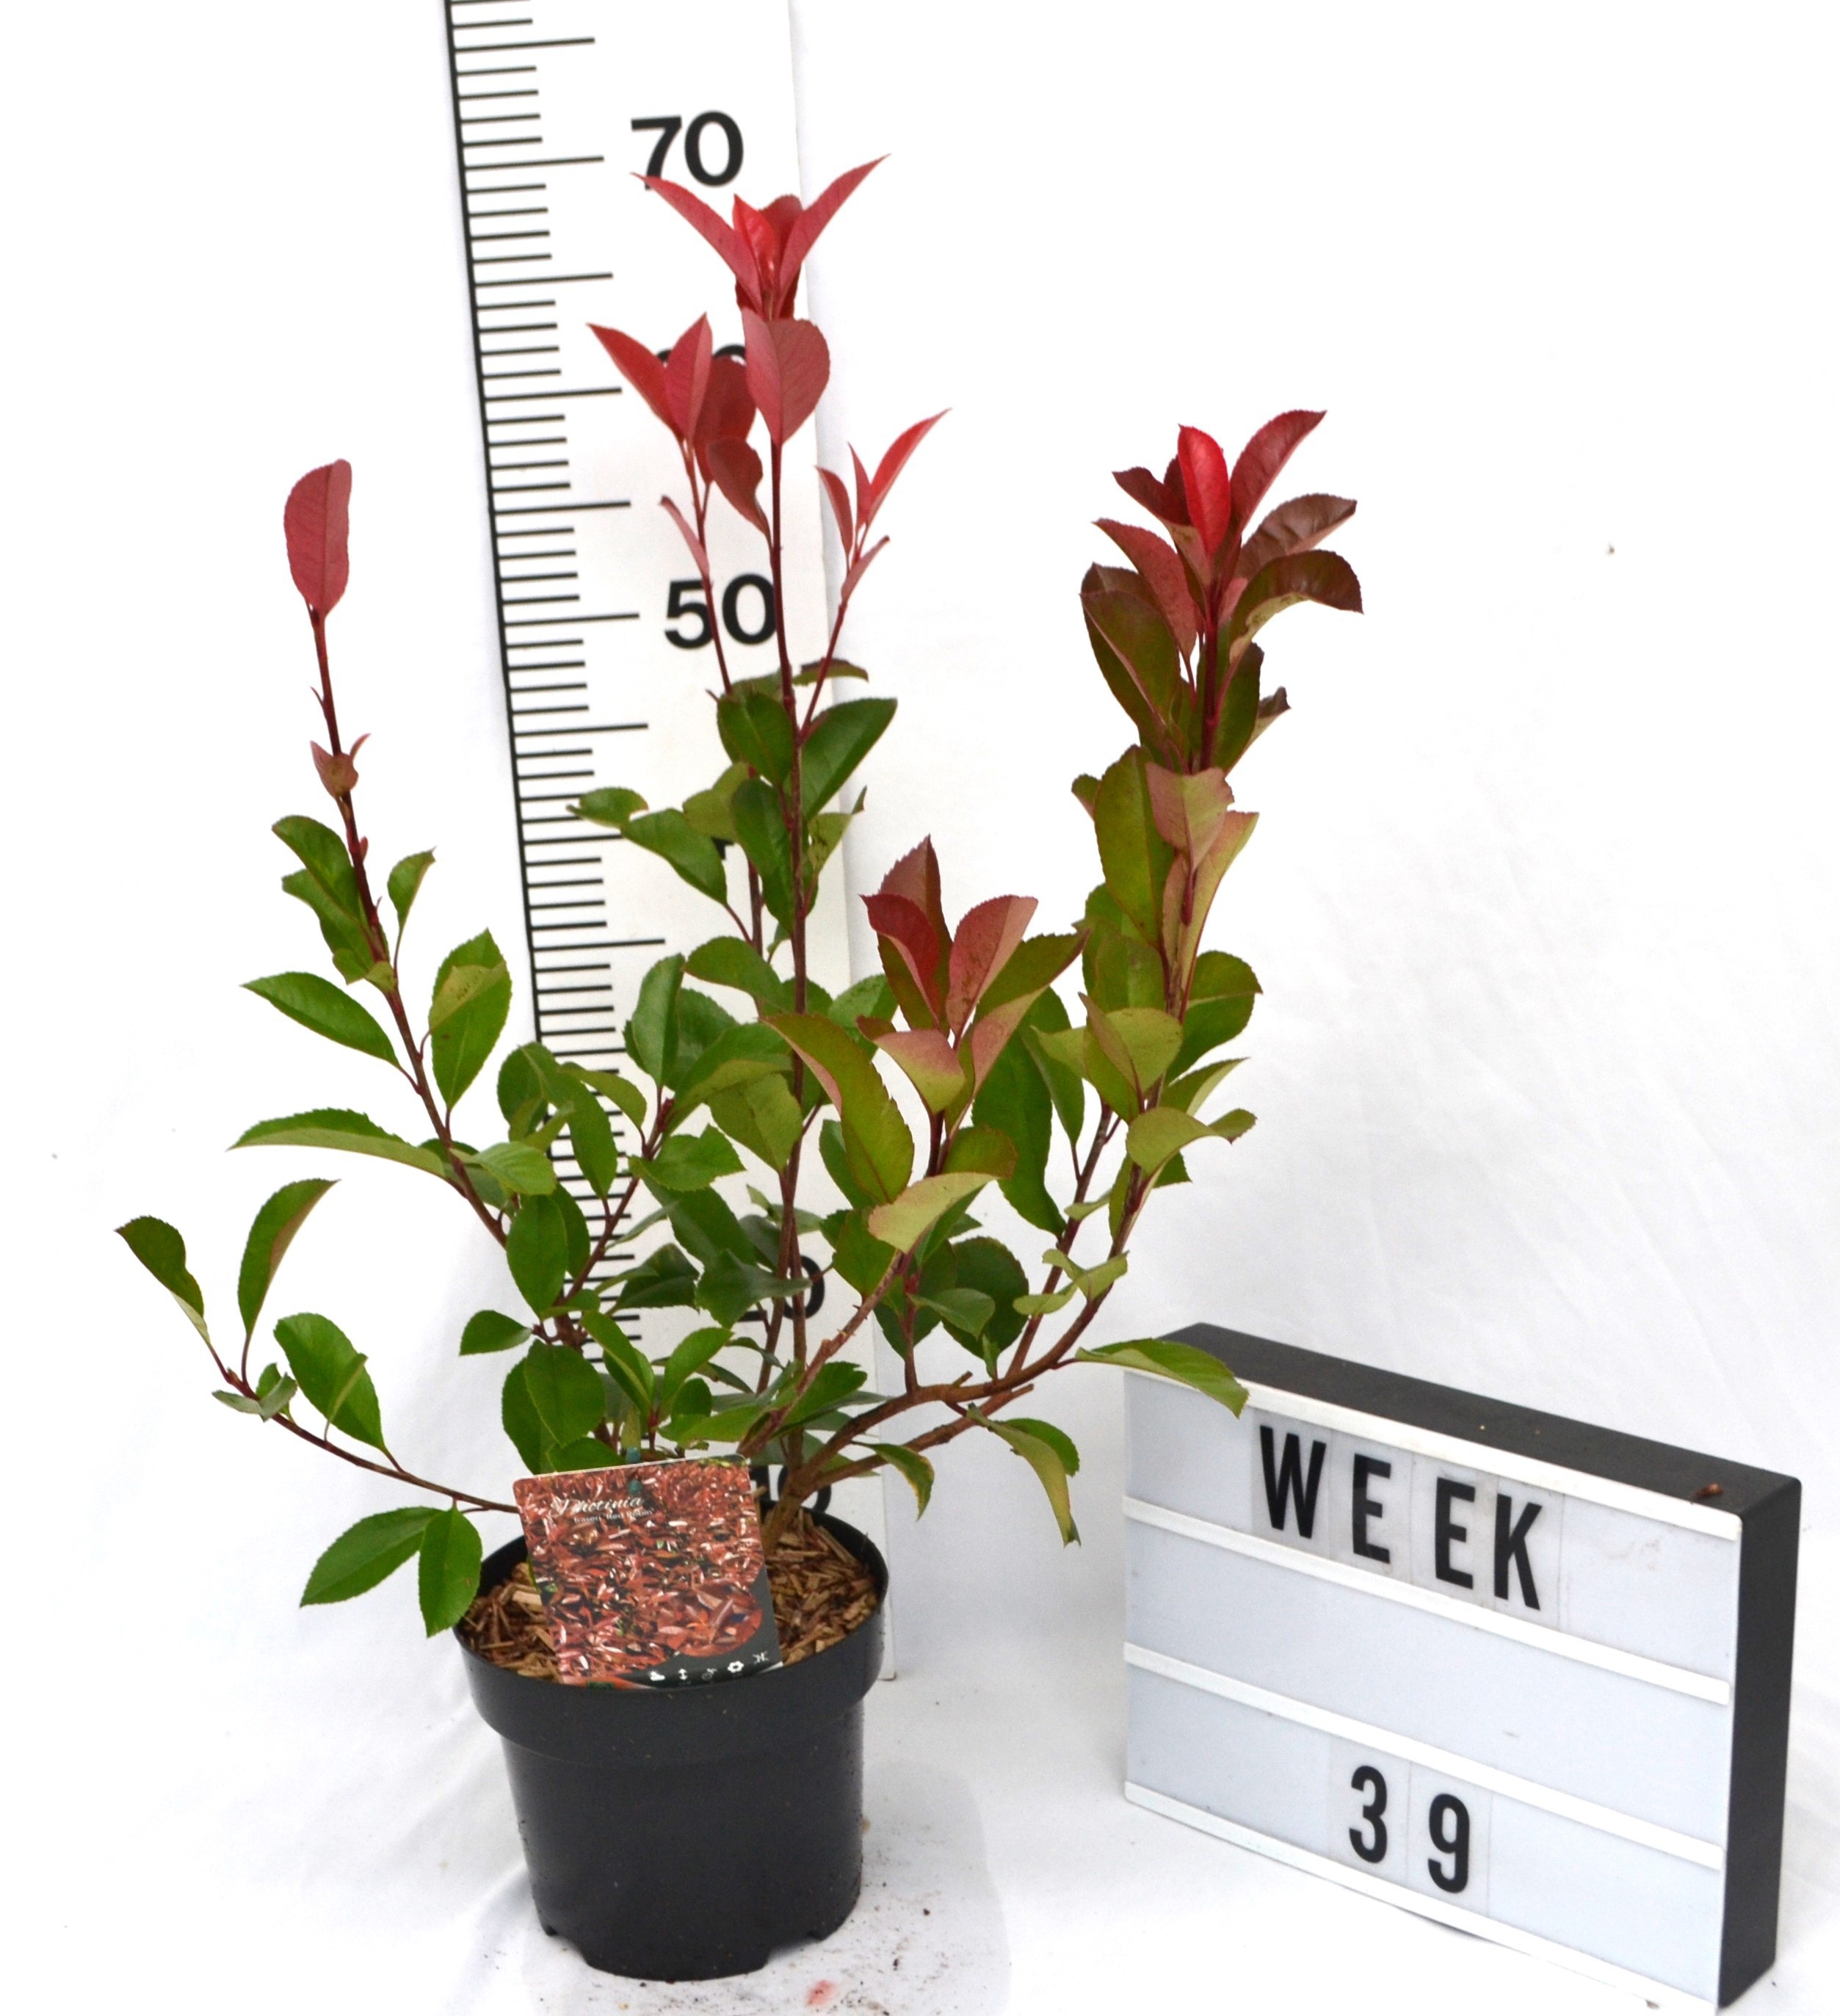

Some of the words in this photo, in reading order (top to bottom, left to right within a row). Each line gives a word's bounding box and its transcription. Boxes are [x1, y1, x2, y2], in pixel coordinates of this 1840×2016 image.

[631, 110, 744, 189] 70
[664, 573, 777, 650] 50
[1259, 1424, 1543, 1611] WEEK
[1349, 1765, 1471, 1894] 39
